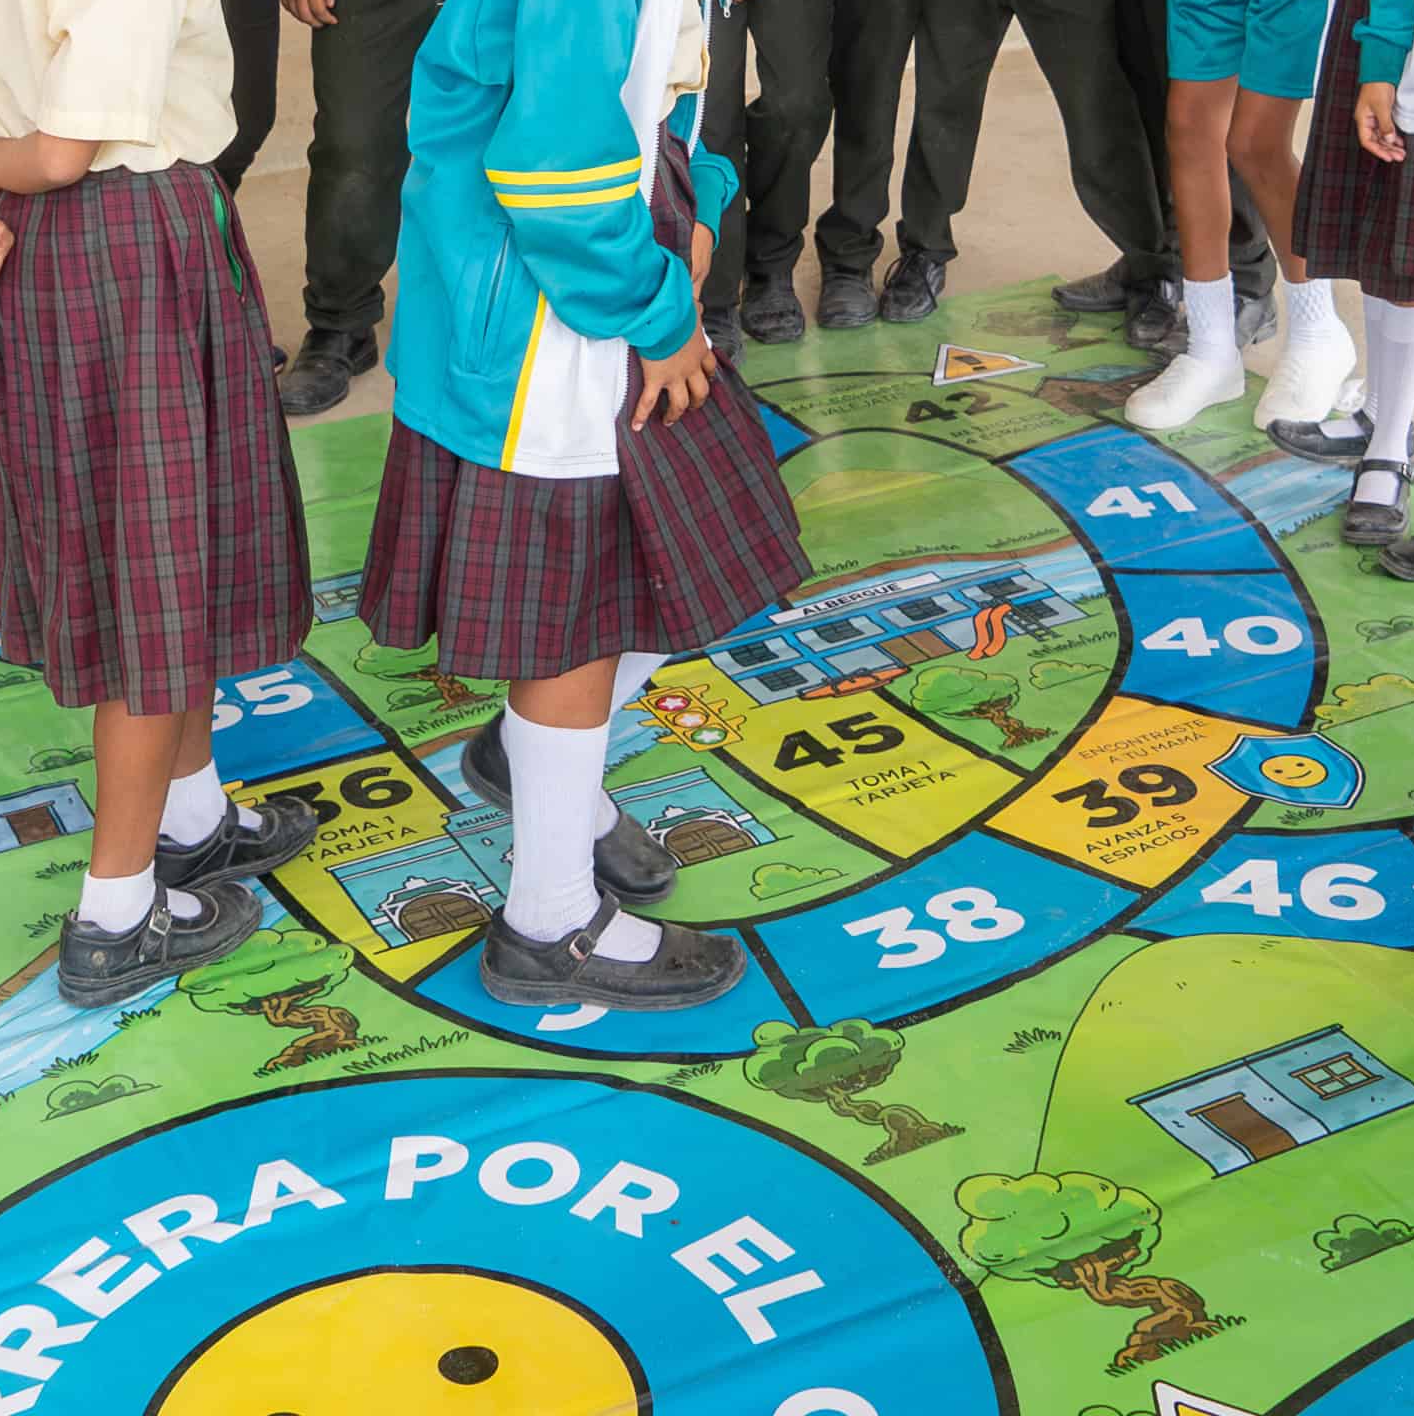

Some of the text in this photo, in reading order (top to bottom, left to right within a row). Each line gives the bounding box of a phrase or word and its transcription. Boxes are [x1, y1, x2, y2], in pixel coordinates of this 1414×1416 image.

[904, 390, 1010, 425] 42
[1086, 481, 1199, 521] 41
[802, 582, 904, 617] ALBERGUE
[1140, 615, 1304, 658] 40
[773, 711, 905, 772] 45
[1077, 718, 1209, 761] ENCONTRASTE
[1121, 749, 1148, 763] TU
[845, 760, 932, 792] TOMA 1
[847, 770, 957, 806] TARJETA
[1051, 764, 1198, 828] 39
[455, 809, 508, 830] MUNIC
[1085, 812, 1187, 854] AVANZA 5
[303, 826, 419, 863] TARJETA
[1098, 824, 1200, 865] ESPACIOS
[1201, 859, 1386, 922] 46
[843, 887, 1026, 971] 38
[386, 1135, 680, 1238] POR
[669, 1214, 827, 1345] EL
